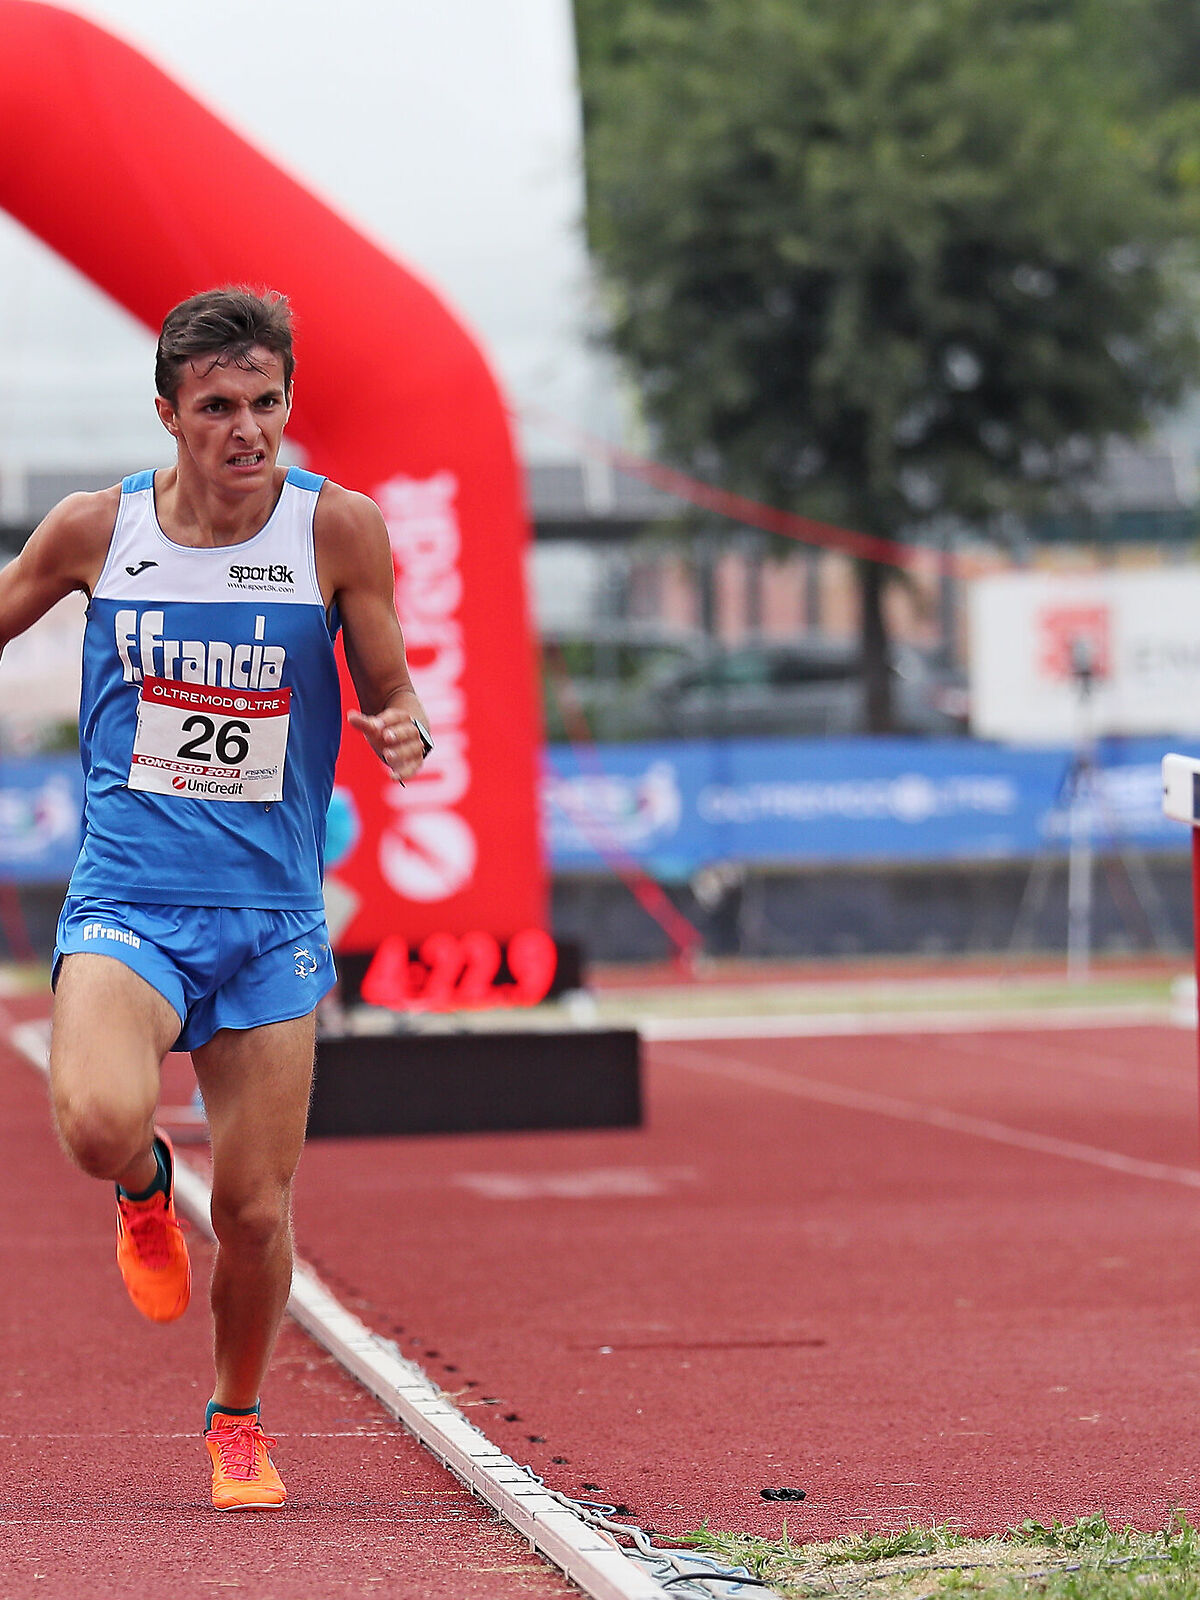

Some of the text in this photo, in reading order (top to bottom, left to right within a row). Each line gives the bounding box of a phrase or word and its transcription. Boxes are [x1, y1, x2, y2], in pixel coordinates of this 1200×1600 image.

[228, 564, 295, 584] sport3k
[176, 714, 252, 765] 26
[136, 755, 204, 775] CONCESIO
[205, 766, 239, 778] 2021
[186, 778, 245, 795] UniCredit
